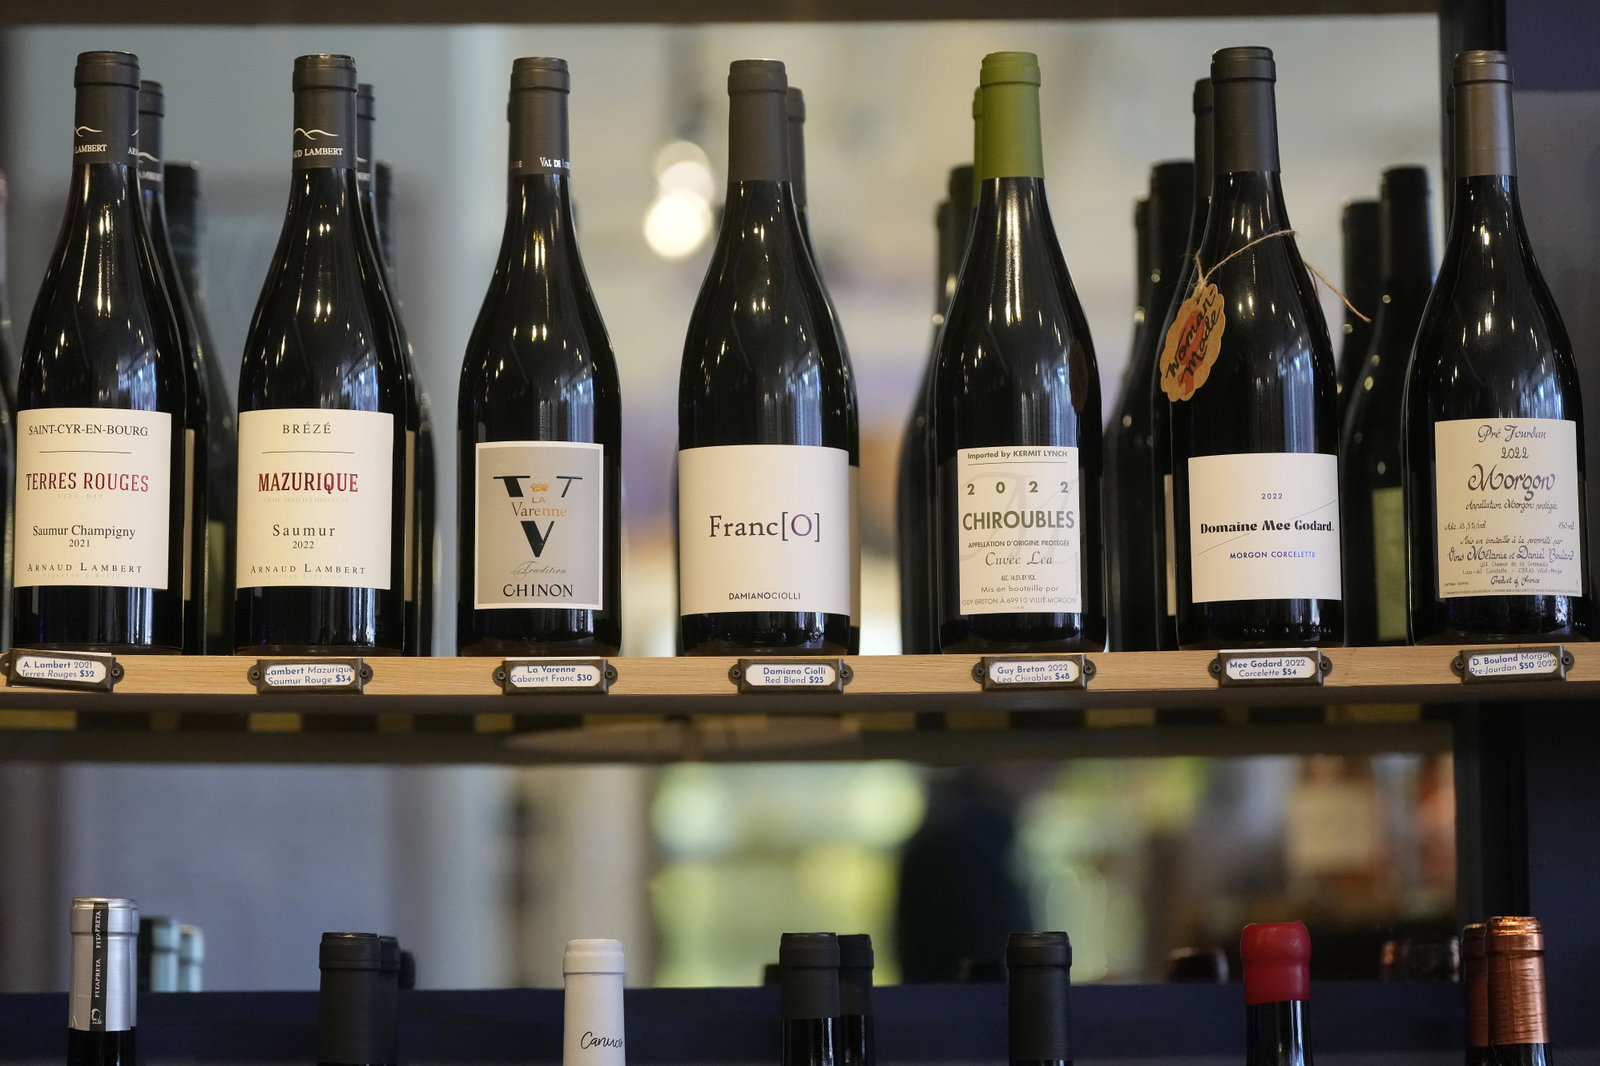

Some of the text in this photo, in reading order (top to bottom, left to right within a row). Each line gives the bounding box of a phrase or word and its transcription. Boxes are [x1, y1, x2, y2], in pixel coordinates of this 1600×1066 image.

[75, 144, 107, 154] LAMBERT
[304, 148, 343, 156] LAMBERT
[29, 424, 148, 437] SAINT-CYR-EN-BOURG
[282, 421, 332, 435] BRÉZÉ
[967, 451, 999, 461] Imported
[1001, 451, 1012, 459] by
[1013, 450, 1041, 458] KERMIT
[1501, 447, 1529, 459] 2022
[26, 473, 149, 493] TERRES ROUGES
[258, 472, 359, 495] MAZURIQUE
[1468, 463, 1556, 501] Morgon
[1261, 492, 1284, 500] 2022
[511, 501, 567, 517] Varenne
[962, 510, 1075, 531] CHIROUBLES
[33, 525, 136, 540] Saumur Champigny
[272, 524, 336, 537] Saumur
[709, 511, 820, 543] Franc[O]
[1200, 521, 1258, 535] Domaine
[1261, 520, 1291, 532] Mee
[69, 539, 90, 548] 2021
[292, 541, 315, 550] 2022
[968, 540, 1005, 549] APPELLATION
[1006, 539, 1040, 547] D'ORIGINE
[1229, 551, 1316, 560] MORGON CORCELETTE
[27, 562, 142, 574] ARNAUD LAMBERT
[250, 564, 365, 575] ARNAUD LAMBERT
[511, 560, 567, 581] Tradition
[502, 583, 574, 597] CHINON
[980, 586, 994, 594] Mis
[1008, 584, 1043, 593] bouteille
[961, 599, 974, 607] GUY
[23, 660, 93, 669] A. Lambert 2021
[1229, 659, 1306, 669] Mee Godard 2022
[1472, 652, 1553, 666] D. Bouland Morgon
[265, 666, 354, 676] Lambert Mazurique
[527, 665, 577, 674] La Varenne
[763, 666, 827, 675] Damiano Ciolli
[997, 664, 1069, 675] Guy Breton 2022
[1470, 659, 1557, 675] Pre-Jourdan $50 2022
[21, 669, 95, 679] Terres Rouges $32
[511, 673, 593, 683] Cabernet Franc $30
[1014, 673, 1053, 683] Chirobles
[1055, 672, 1070, 681] $48
[1239, 668, 1297, 678] Corcelette $54
[268, 674, 352, 685] Saumur Rouge $34
[765, 676, 824, 684] Red Blend $25
